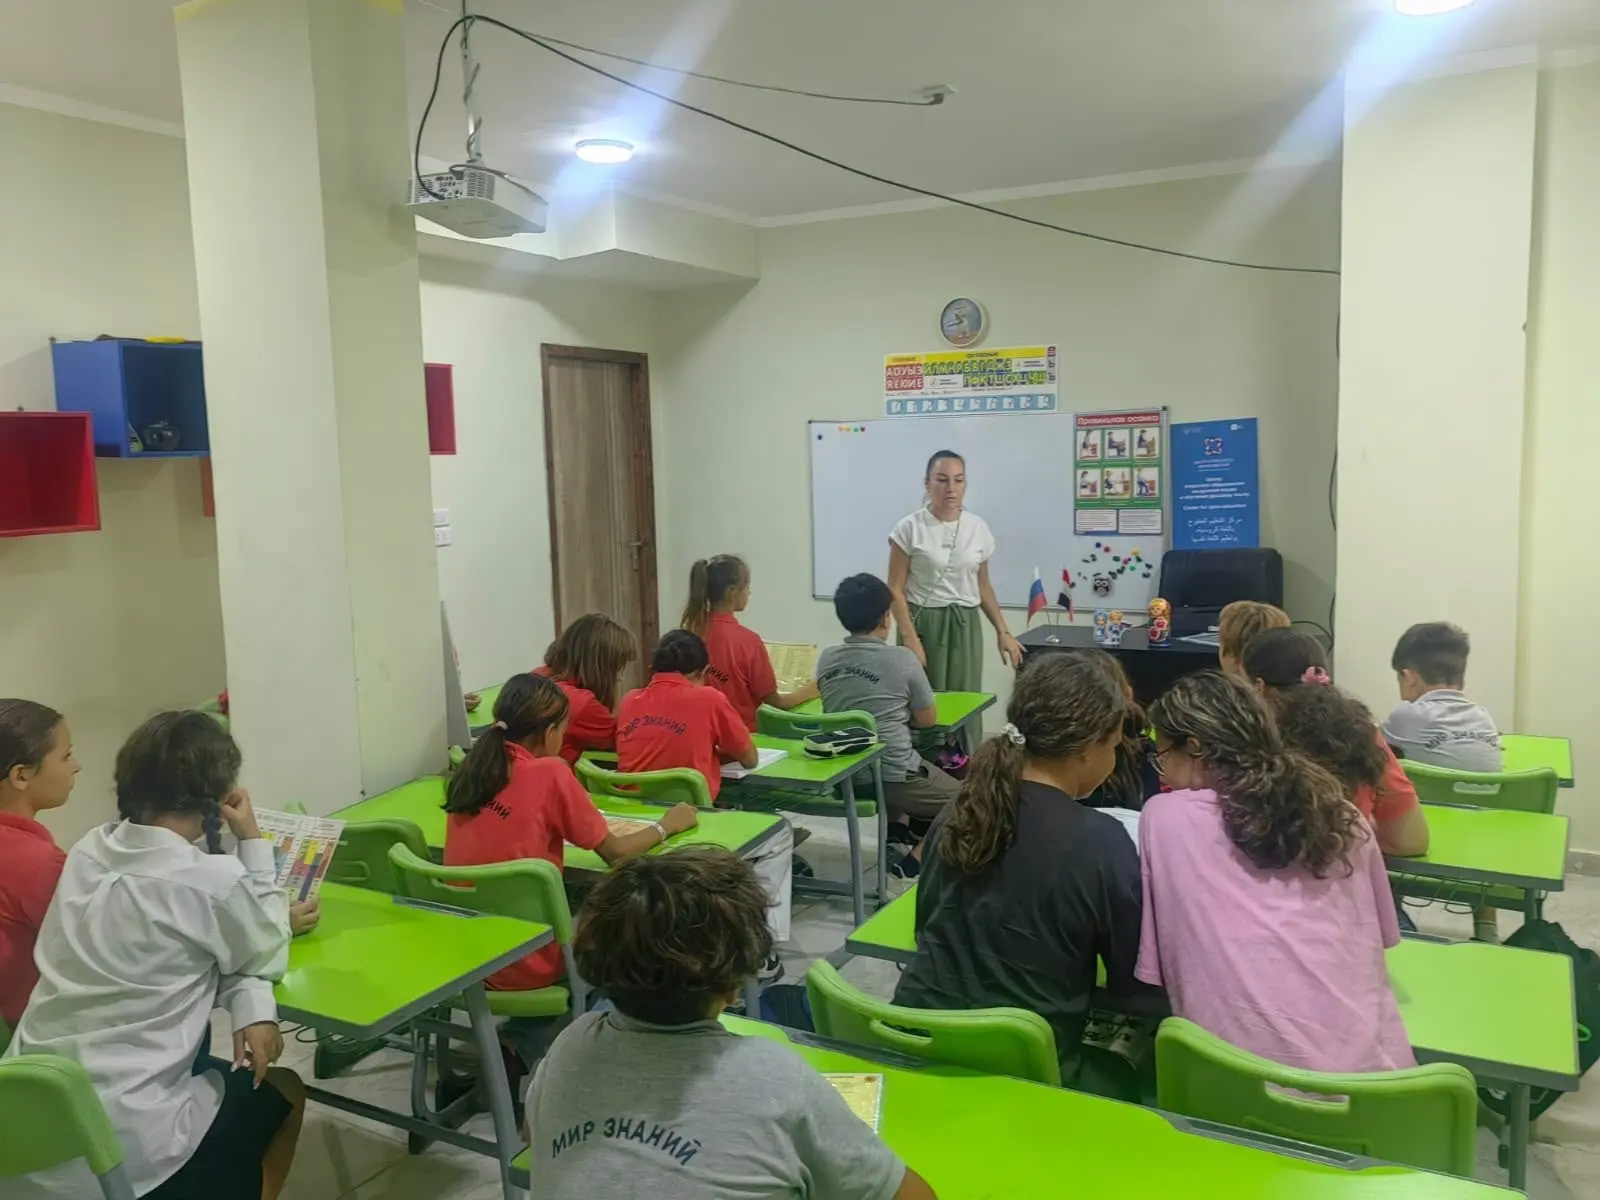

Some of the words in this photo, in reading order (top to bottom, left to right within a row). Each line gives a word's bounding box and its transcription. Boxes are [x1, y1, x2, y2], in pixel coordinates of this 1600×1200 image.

[643, 714, 687, 736] ЗНАНИЙ
[484, 800, 512, 820] НИЙ
[552, 1120, 595, 1159] МИР
[603, 1117, 702, 1166] ЗНАНИЙ
